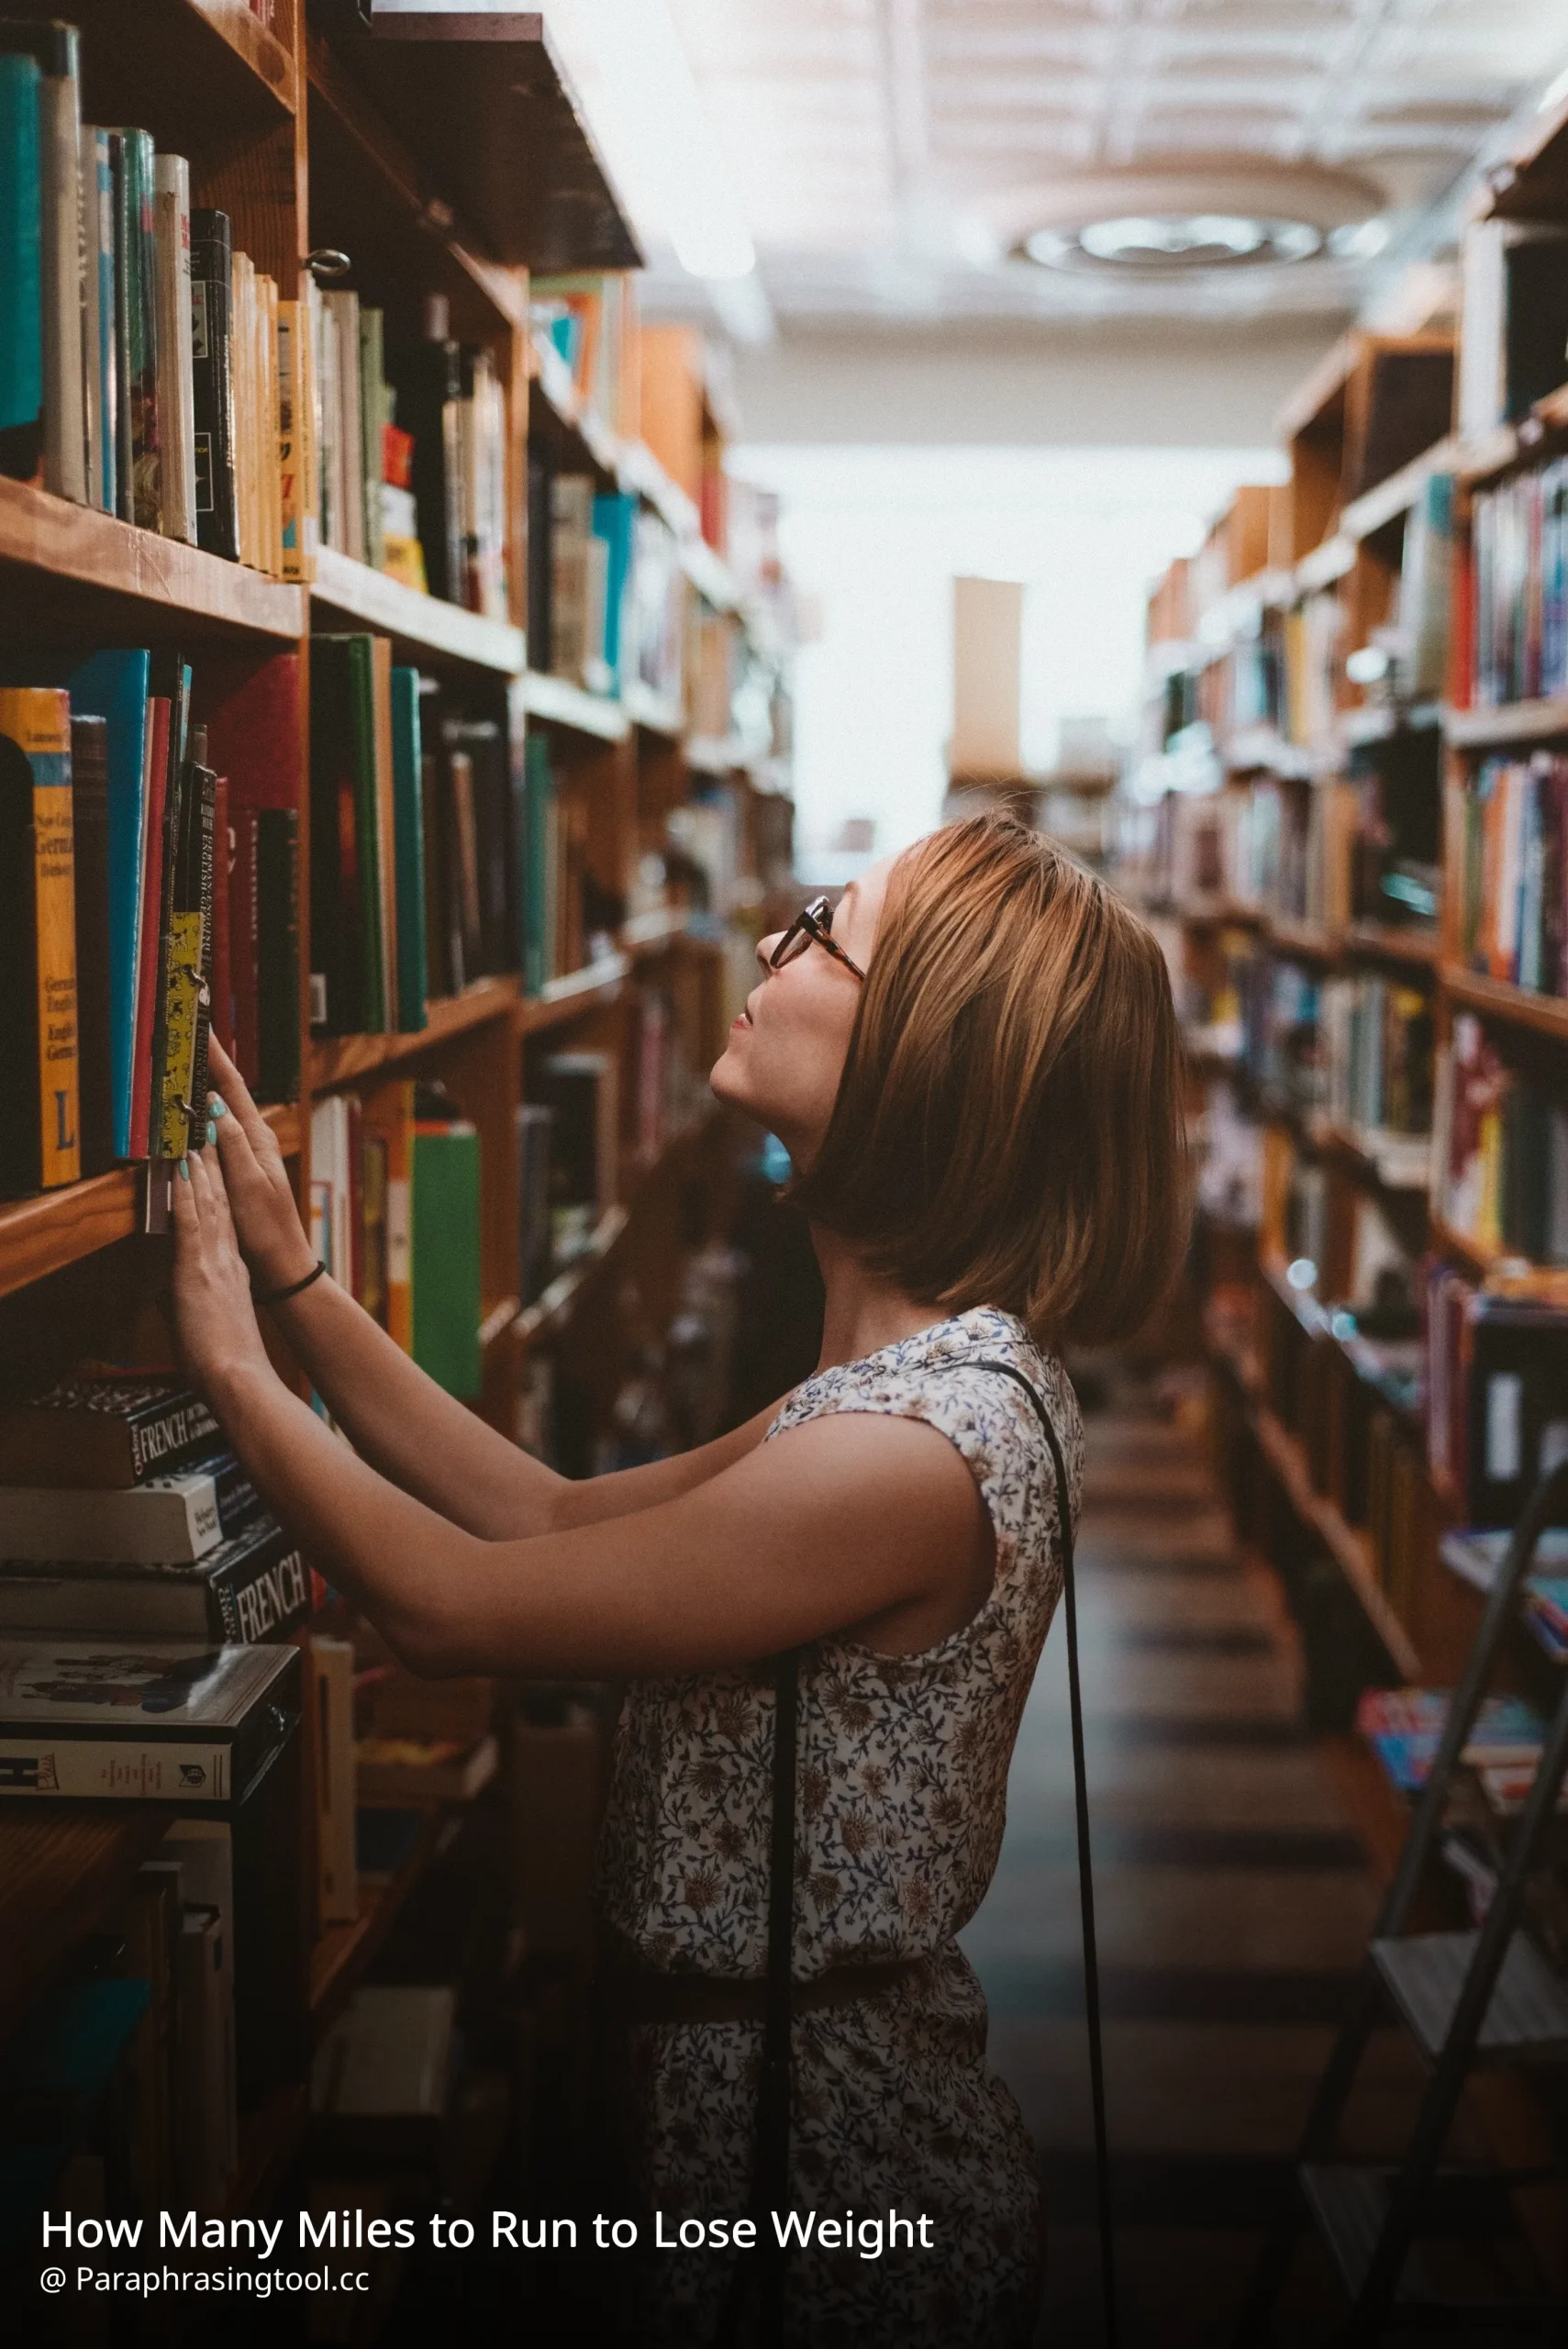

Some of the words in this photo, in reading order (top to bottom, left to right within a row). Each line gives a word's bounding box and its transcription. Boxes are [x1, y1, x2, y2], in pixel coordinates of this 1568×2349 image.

[53, 1090, 75, 1150] L
[139, 1409, 189, 1464] FRENCH
[236, 1550, 306, 1645] FRENCH
